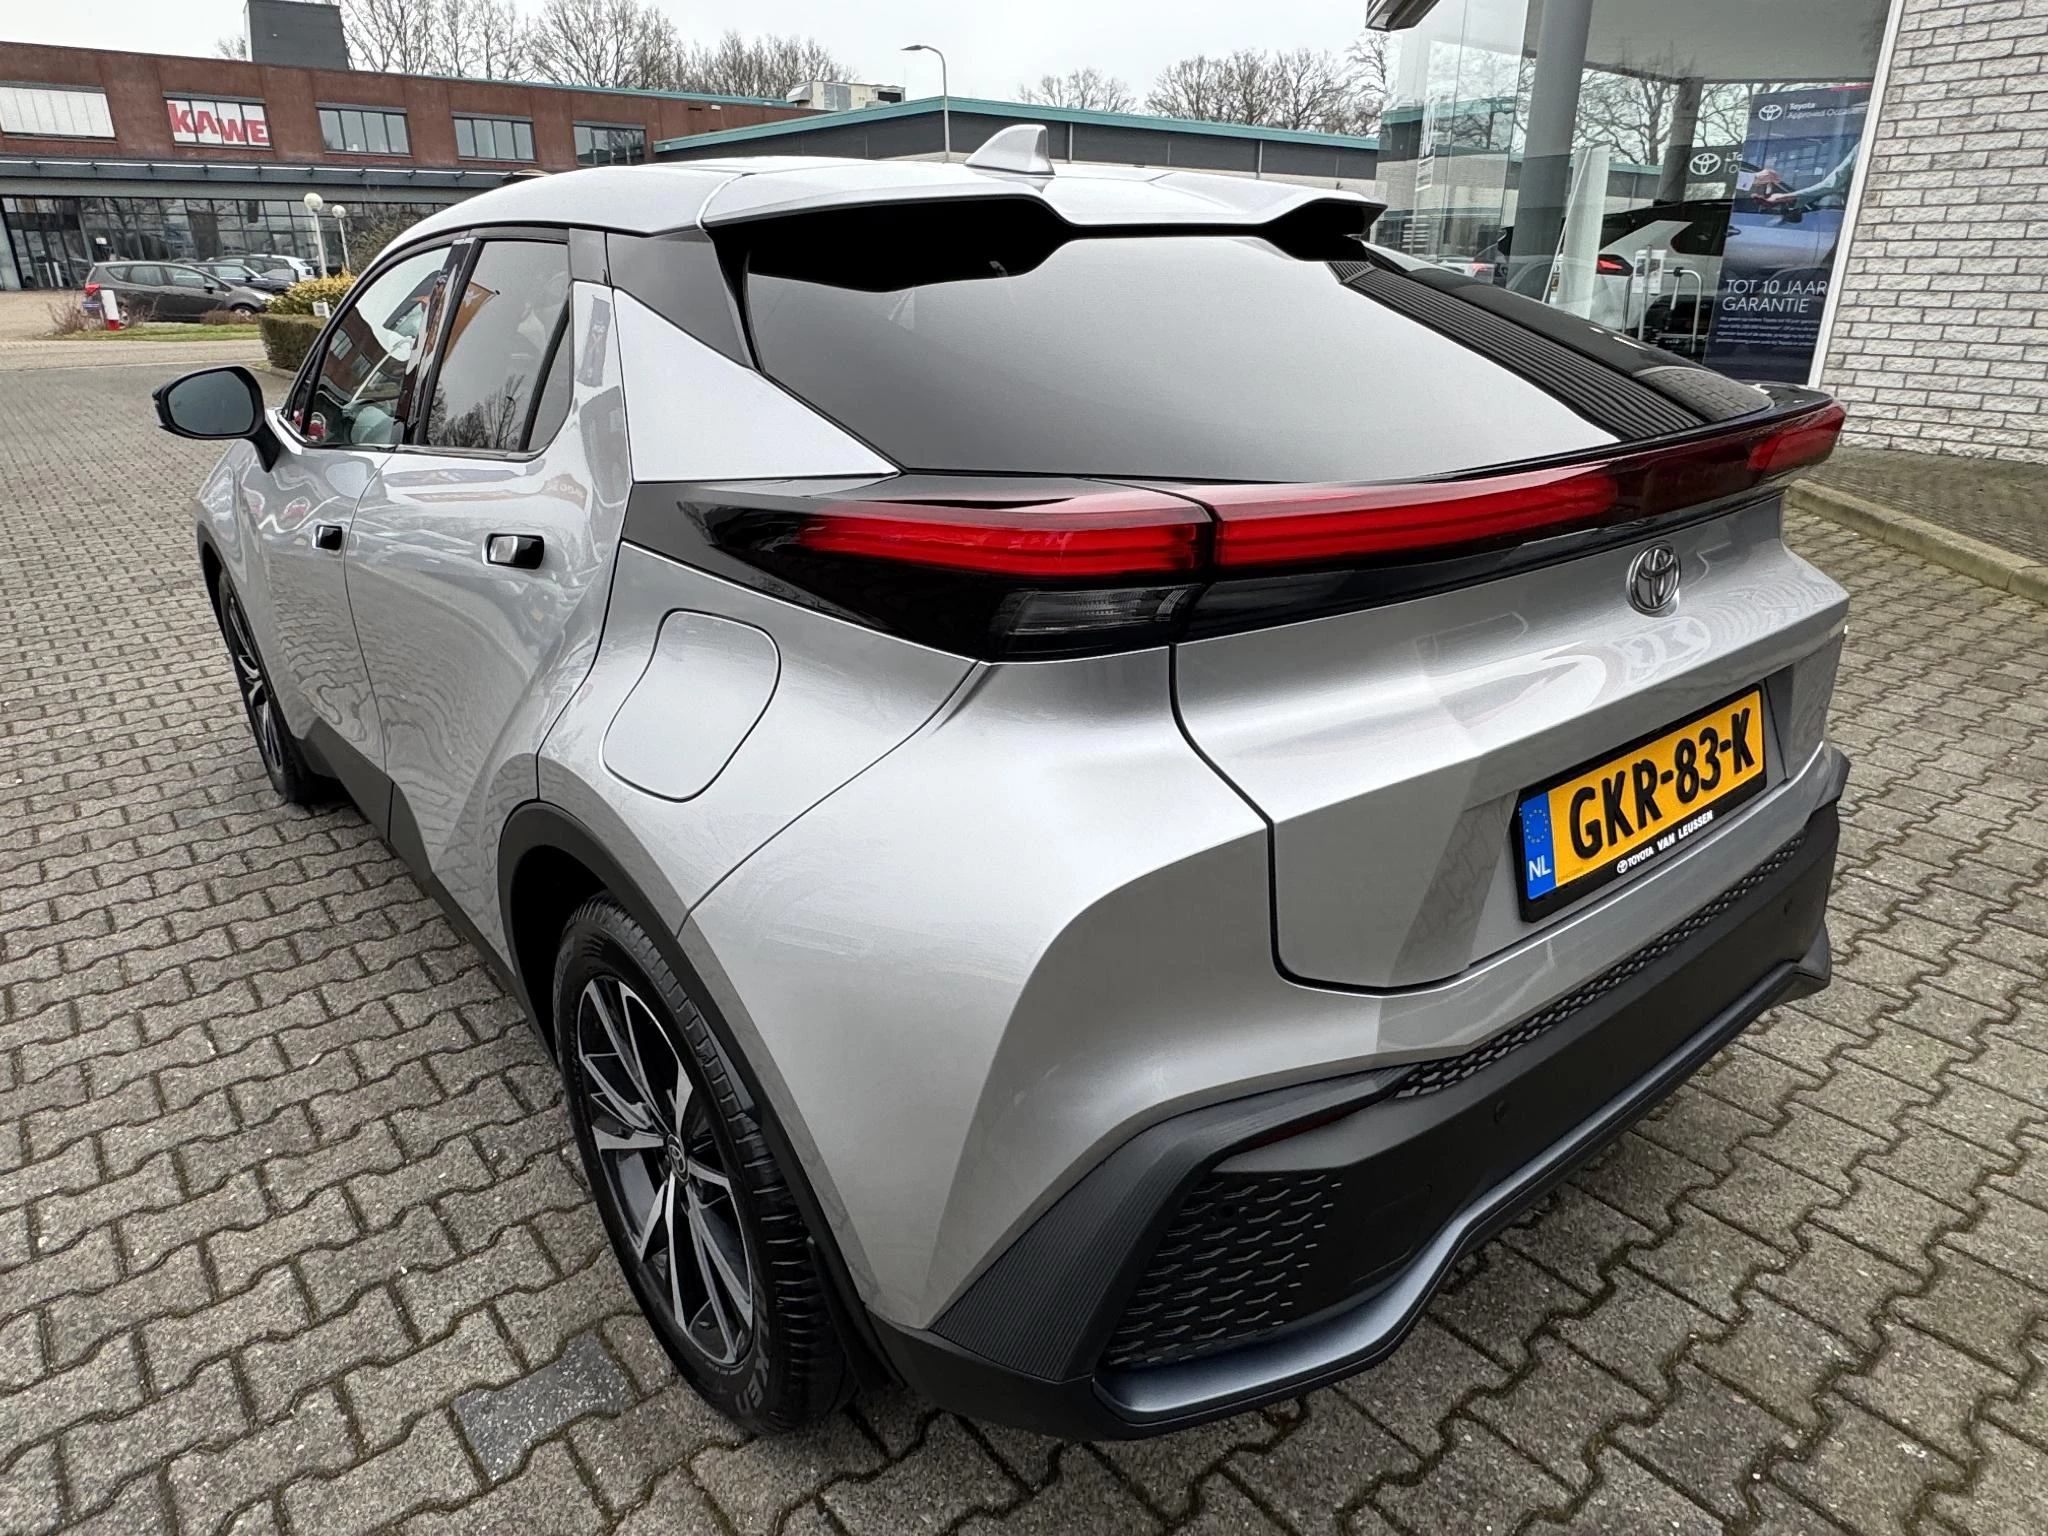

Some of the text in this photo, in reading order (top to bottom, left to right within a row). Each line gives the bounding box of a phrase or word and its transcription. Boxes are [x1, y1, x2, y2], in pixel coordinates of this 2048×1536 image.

[1789, 102, 1816, 111] Toyota
[1726, 279, 1828, 295] TOT 10 JAAR
[1722, 297, 1810, 313] GARANTIE
[1569, 708, 1755, 860] GKR-83-K
[1627, 809, 1713, 868] TOYOTA VAN LEUSSEN
[1529, 860, 1552, 882] NL
